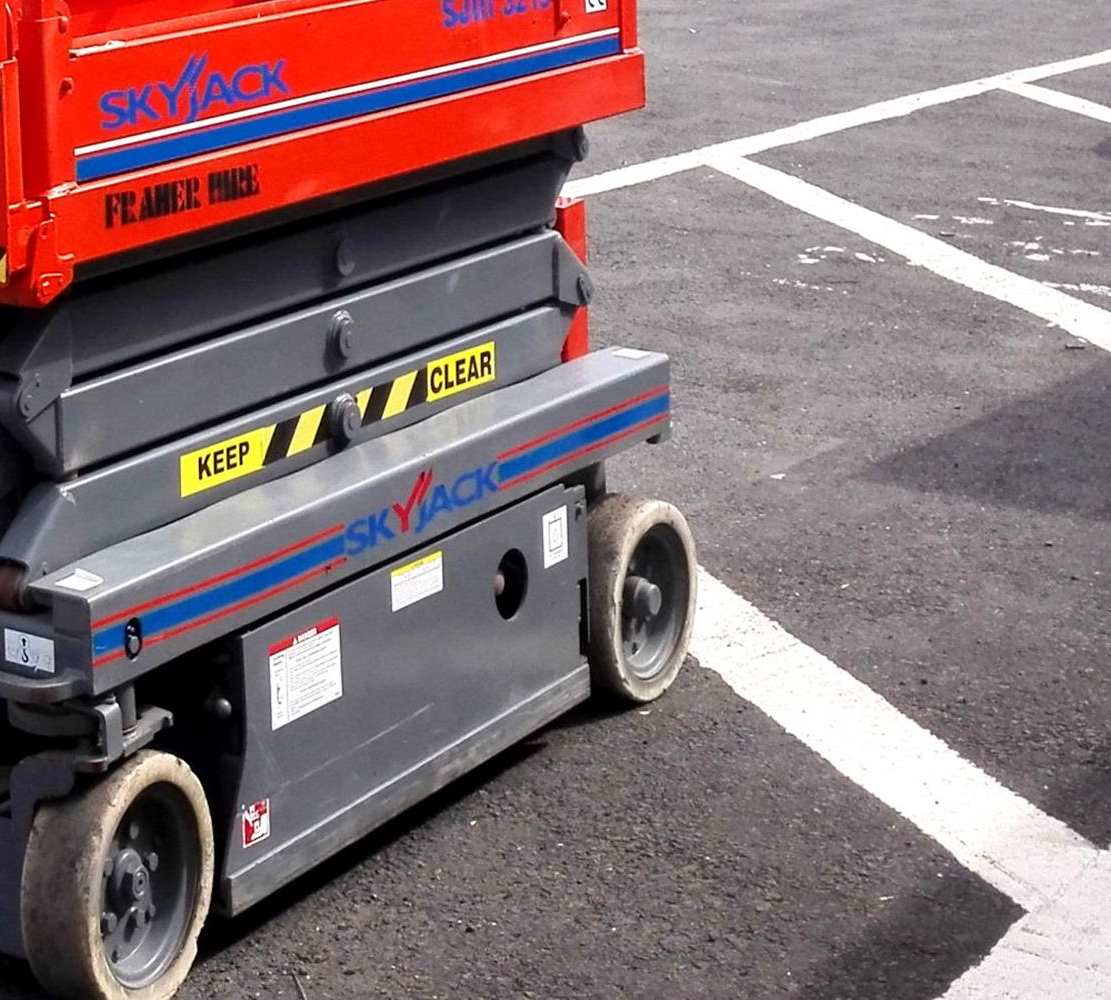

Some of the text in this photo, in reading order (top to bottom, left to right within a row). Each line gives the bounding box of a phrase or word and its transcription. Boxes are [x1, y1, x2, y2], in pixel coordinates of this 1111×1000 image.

[99, 51, 290, 130] SKYJACK
[197, 350, 492, 481] KEEP CLEAR
[345, 467, 499, 556] SKYJACK
